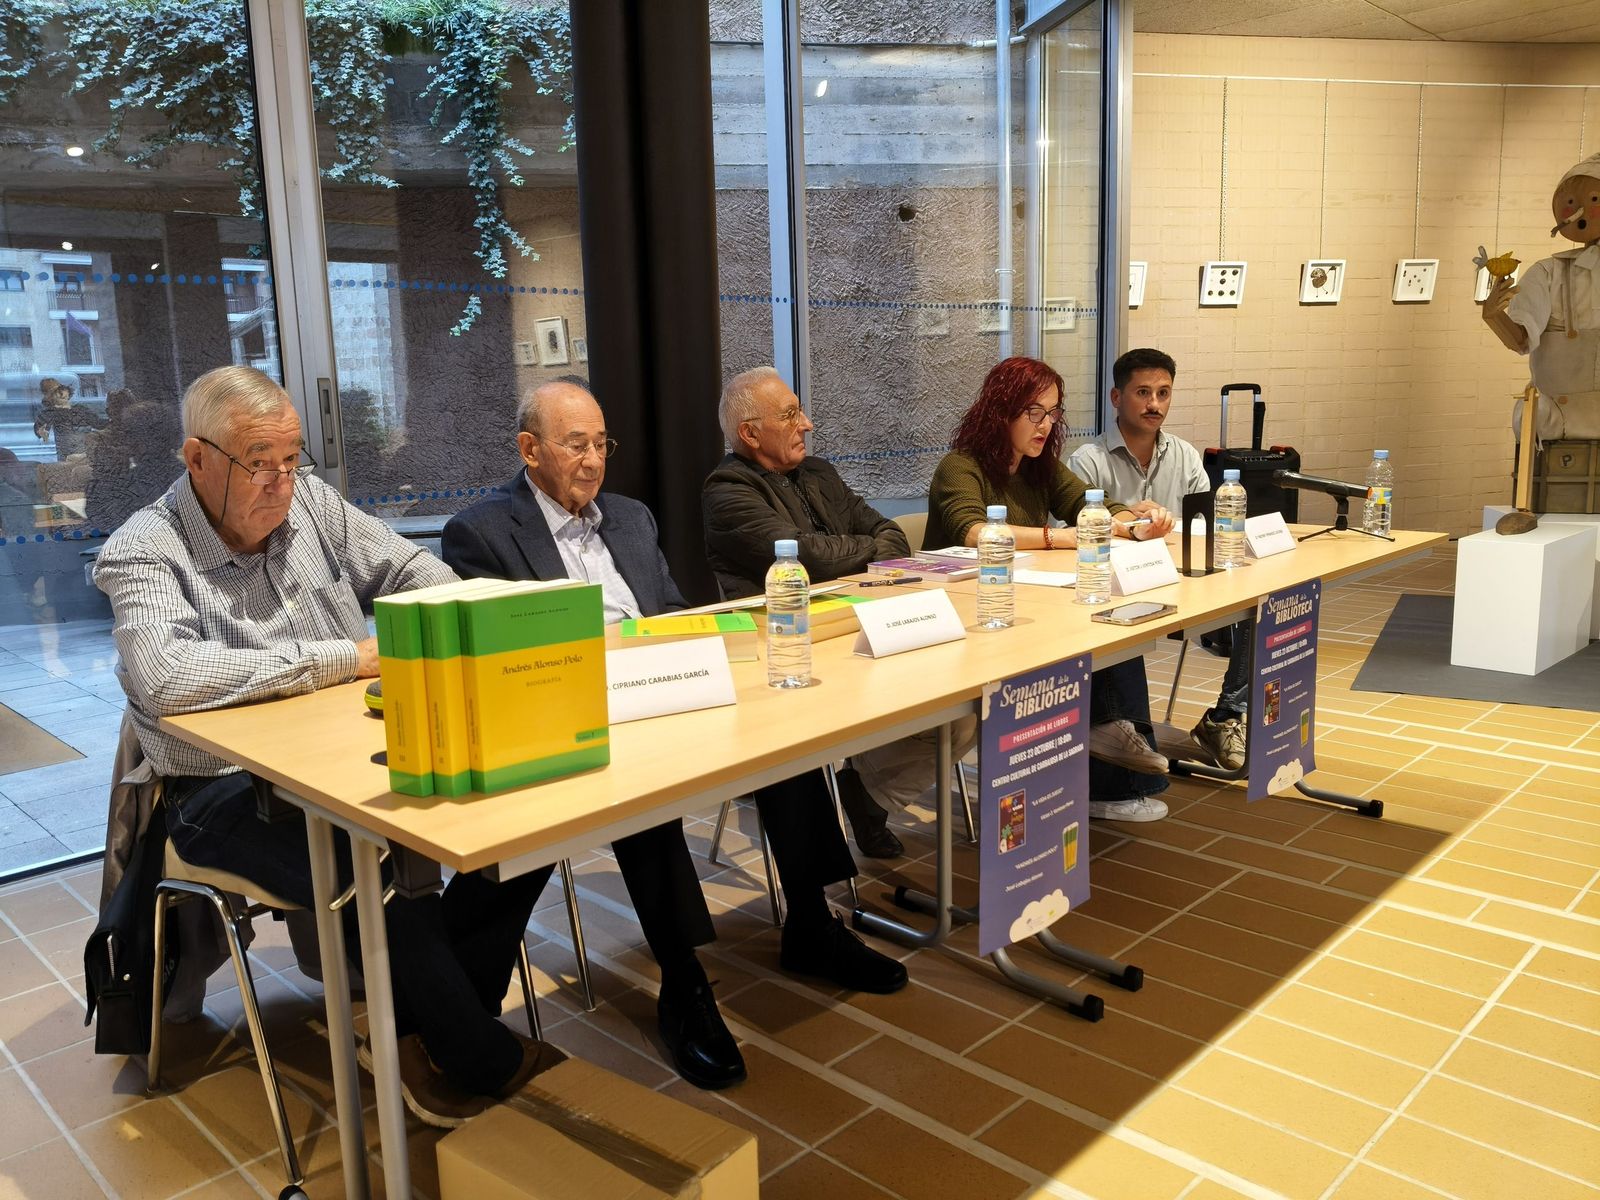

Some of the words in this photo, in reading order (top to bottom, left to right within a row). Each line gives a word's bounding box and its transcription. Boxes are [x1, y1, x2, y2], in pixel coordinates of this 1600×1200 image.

[1562, 454, 1572, 466] P
[1275, 599, 1313, 625] BIBLIOTECA
[534, 658, 563, 669] Alonso
[564, 654, 583, 665] Polo
[612, 678, 647, 690] CIPRIANO
[648, 673, 683, 685] CARABIAS
[684, 669, 710, 680] GARCÍA
[1000, 676, 1055, 707] Semana
[1014, 681, 1080, 720] BIBLIOTECA
